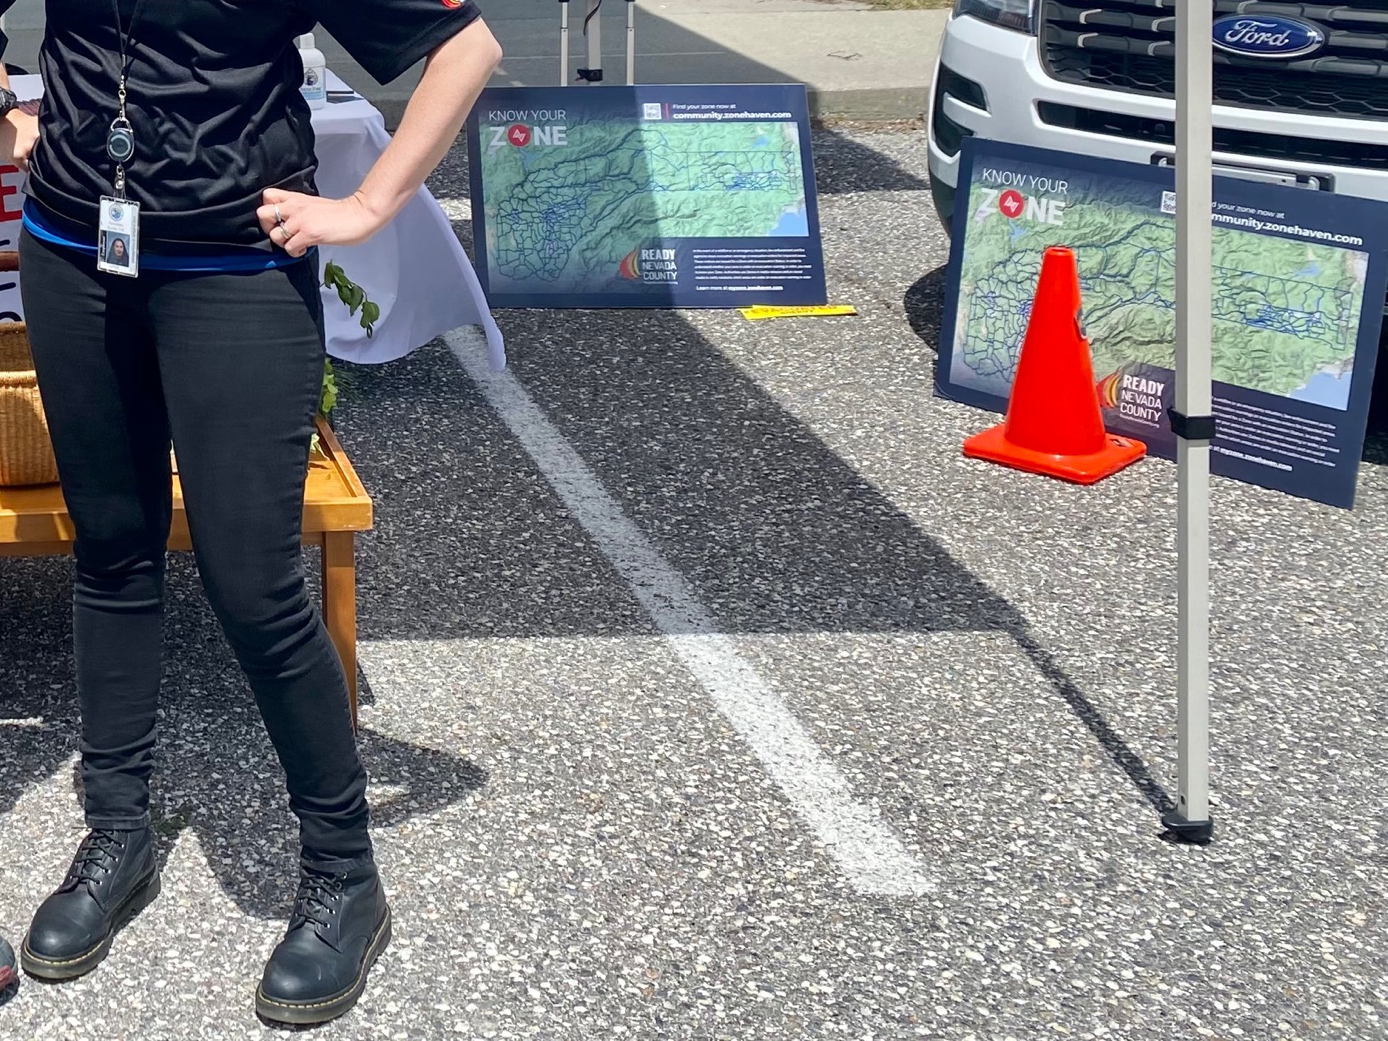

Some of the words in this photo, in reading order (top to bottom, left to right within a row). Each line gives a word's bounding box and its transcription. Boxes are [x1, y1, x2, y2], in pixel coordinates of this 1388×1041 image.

[1225, 20, 1292, 47] Ford
[488, 110, 528, 121] KNOW
[531, 109, 567, 121] YOUR
[673, 111, 792, 121] community.zonehaven.com
[982, 167, 1027, 187] KNOW
[1029, 175, 1069, 195] YOUR
[1236, 206, 1256, 214] zone
[1257, 209, 1276, 217] now
[1212, 213, 1363, 246] mmunity.zonehaven.com
[641, 249, 676, 260] READY
[642, 261, 677, 270] NEVADA
[643, 271, 677, 280] COUNTY
[1123, 374, 1165, 396] READY
[1121, 389, 1162, 410] NEVADA
[1120, 402, 1162, 422] COUNTY
